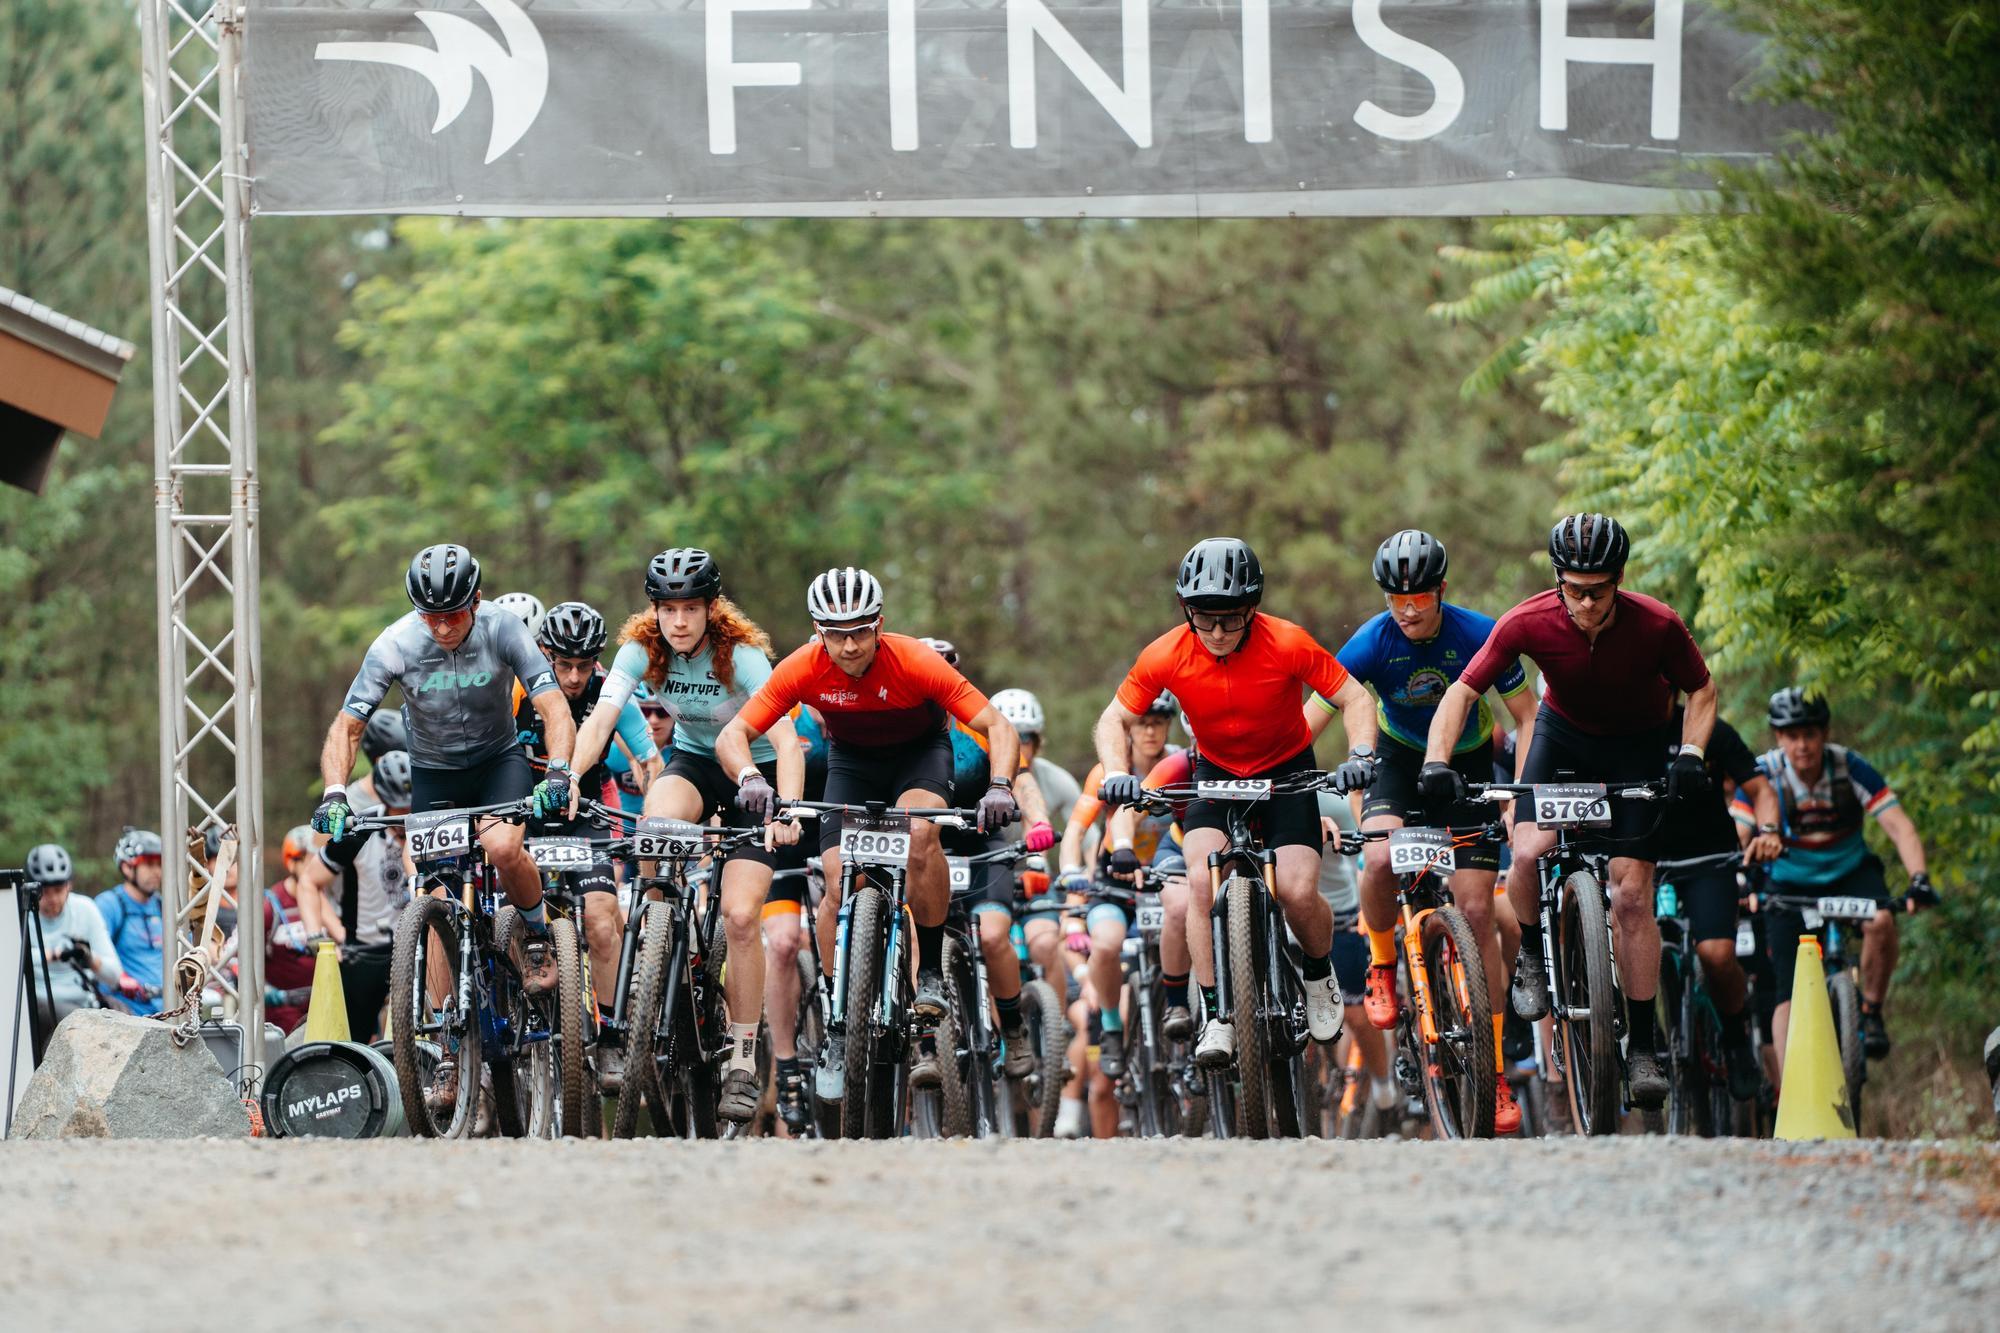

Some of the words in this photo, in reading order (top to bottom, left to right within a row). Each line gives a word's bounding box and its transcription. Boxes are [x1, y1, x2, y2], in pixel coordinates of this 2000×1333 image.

[705, 0, 1683, 154] FINISH
[664, 680, 720, 696] NEWTYPE
[1540, 801, 1606, 820] 8760
[411, 826, 465, 853] 8764
[639, 838, 698, 855] 8767
[844, 833, 906, 856] 8803
[288, 1084, 362, 1118] MYLAPS
